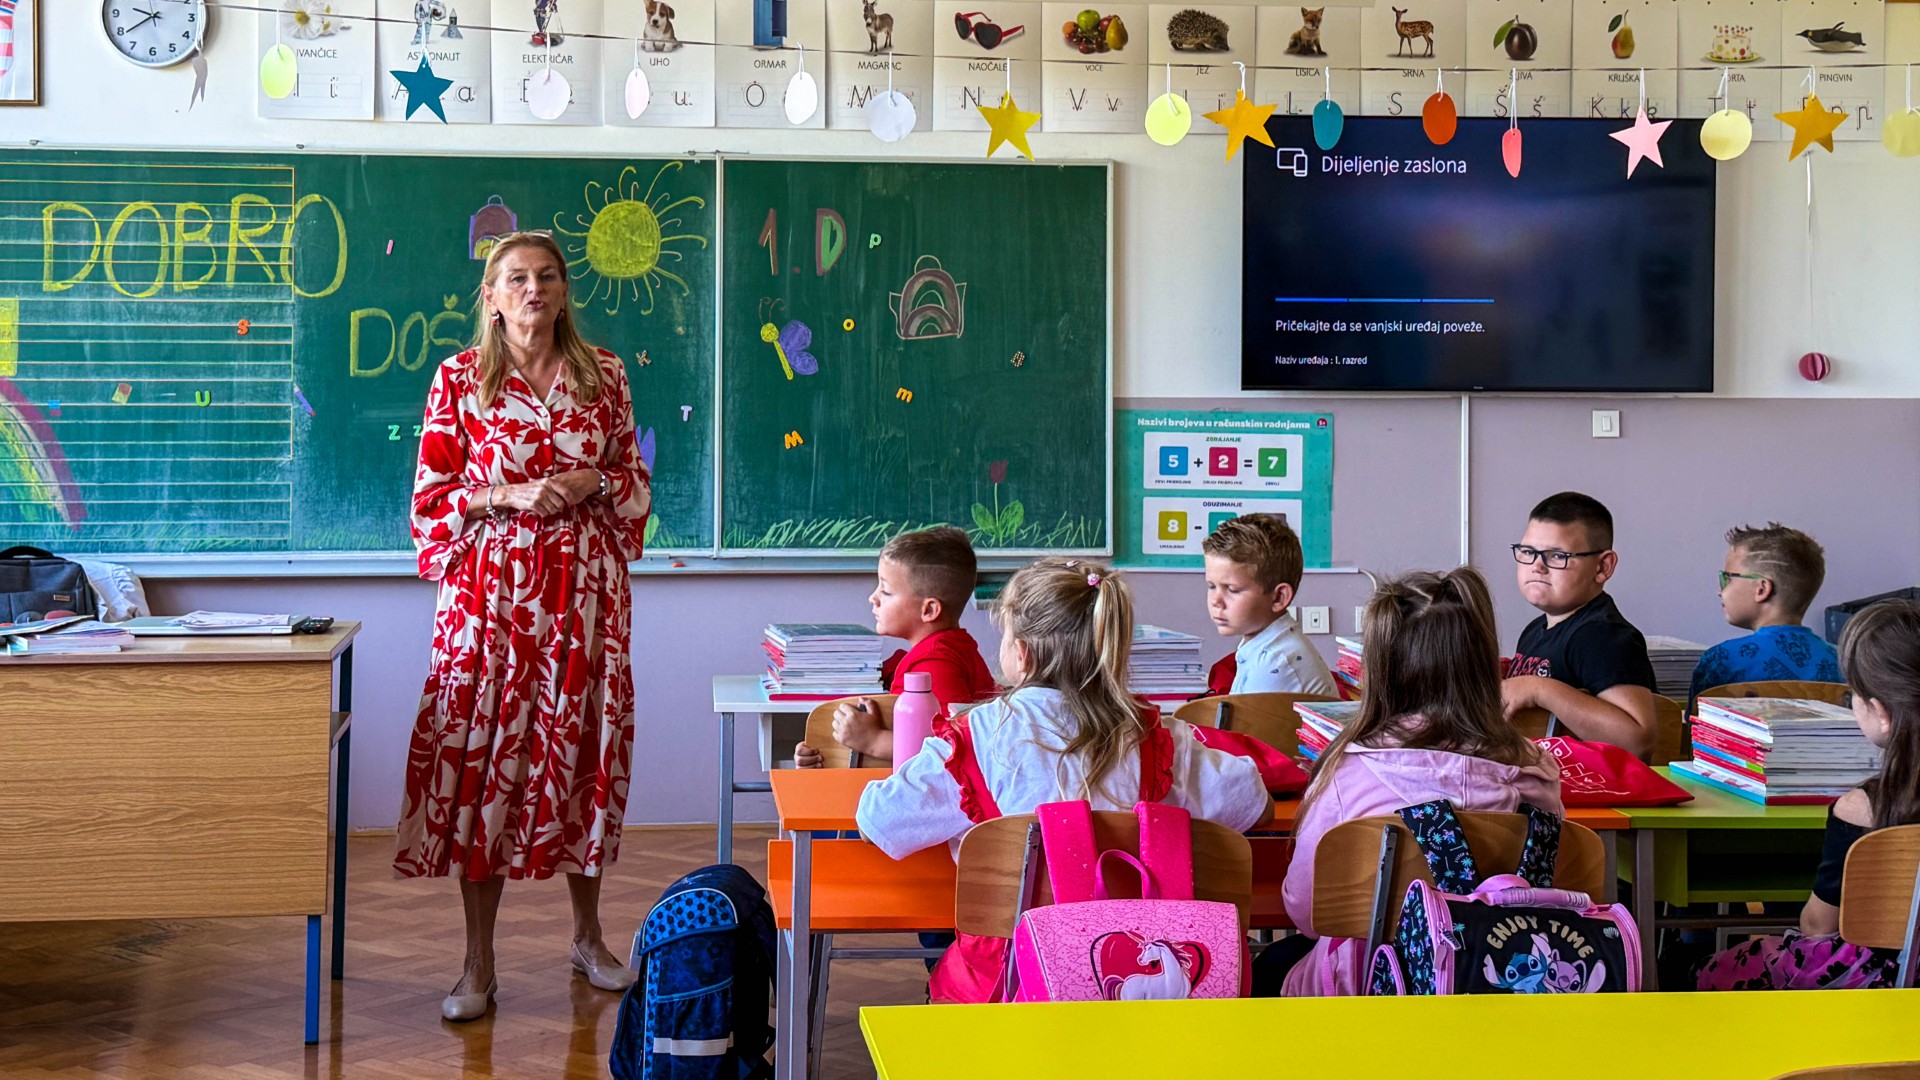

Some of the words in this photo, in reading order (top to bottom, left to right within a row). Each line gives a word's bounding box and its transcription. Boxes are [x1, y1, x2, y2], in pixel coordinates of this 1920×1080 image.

[112, 9, 120, 18] 9
[188, 13, 195, 22] 3
[117, 27, 124, 36] 8
[182, 31, 190, 39] 4
[129, 41, 137, 50] 7
[169, 43, 176, 52] 5
[149, 47, 157, 56] 6
[407, 51, 460, 61] ASONAUT
[650, 58, 670, 66] UHO
[754, 60, 787, 69] ORMAR
[858, 61, 902, 71] MAGARAC
[1402, 70, 1425, 78] SRNA
[1608, 72, 1640, 82] KRUŠKA
[1819, 73, 1852, 82] PINGVIN
[1322, 156, 1399, 176] Dijeljenje
[1403, 157, 1467, 174] zaslona
[42, 193, 348, 298] DOBRO
[1275, 320, 1330, 334] Pričekajte
[1332, 320, 1347, 332] da
[1349, 322, 1362, 332] se
[1364, 320, 1403, 334] vanjski
[1405, 320, 1441, 334] uređaj
[1443, 321, 1485, 334] poveže.
[1275, 355, 1297, 365] Naziv
[1298, 355, 1329, 366] uređaja
[1342, 355, 1368, 365] razred
[680, 405, 693, 422] T
[1137, 418, 1167, 427] Nazivi
[1168, 418, 1205, 428] brojeva
[1213, 418, 1263, 428] računskim
[1264, 420, 1311, 430] radnjama
[1168, 454, 1179, 468] 5
[1218, 454, 1229, 469] 2
[1267, 455, 1279, 470] 7
[1167, 519, 1179, 533] 8
[1486, 915, 1538, 949] ENJOY
[1548, 919, 1594, 958] TIME
